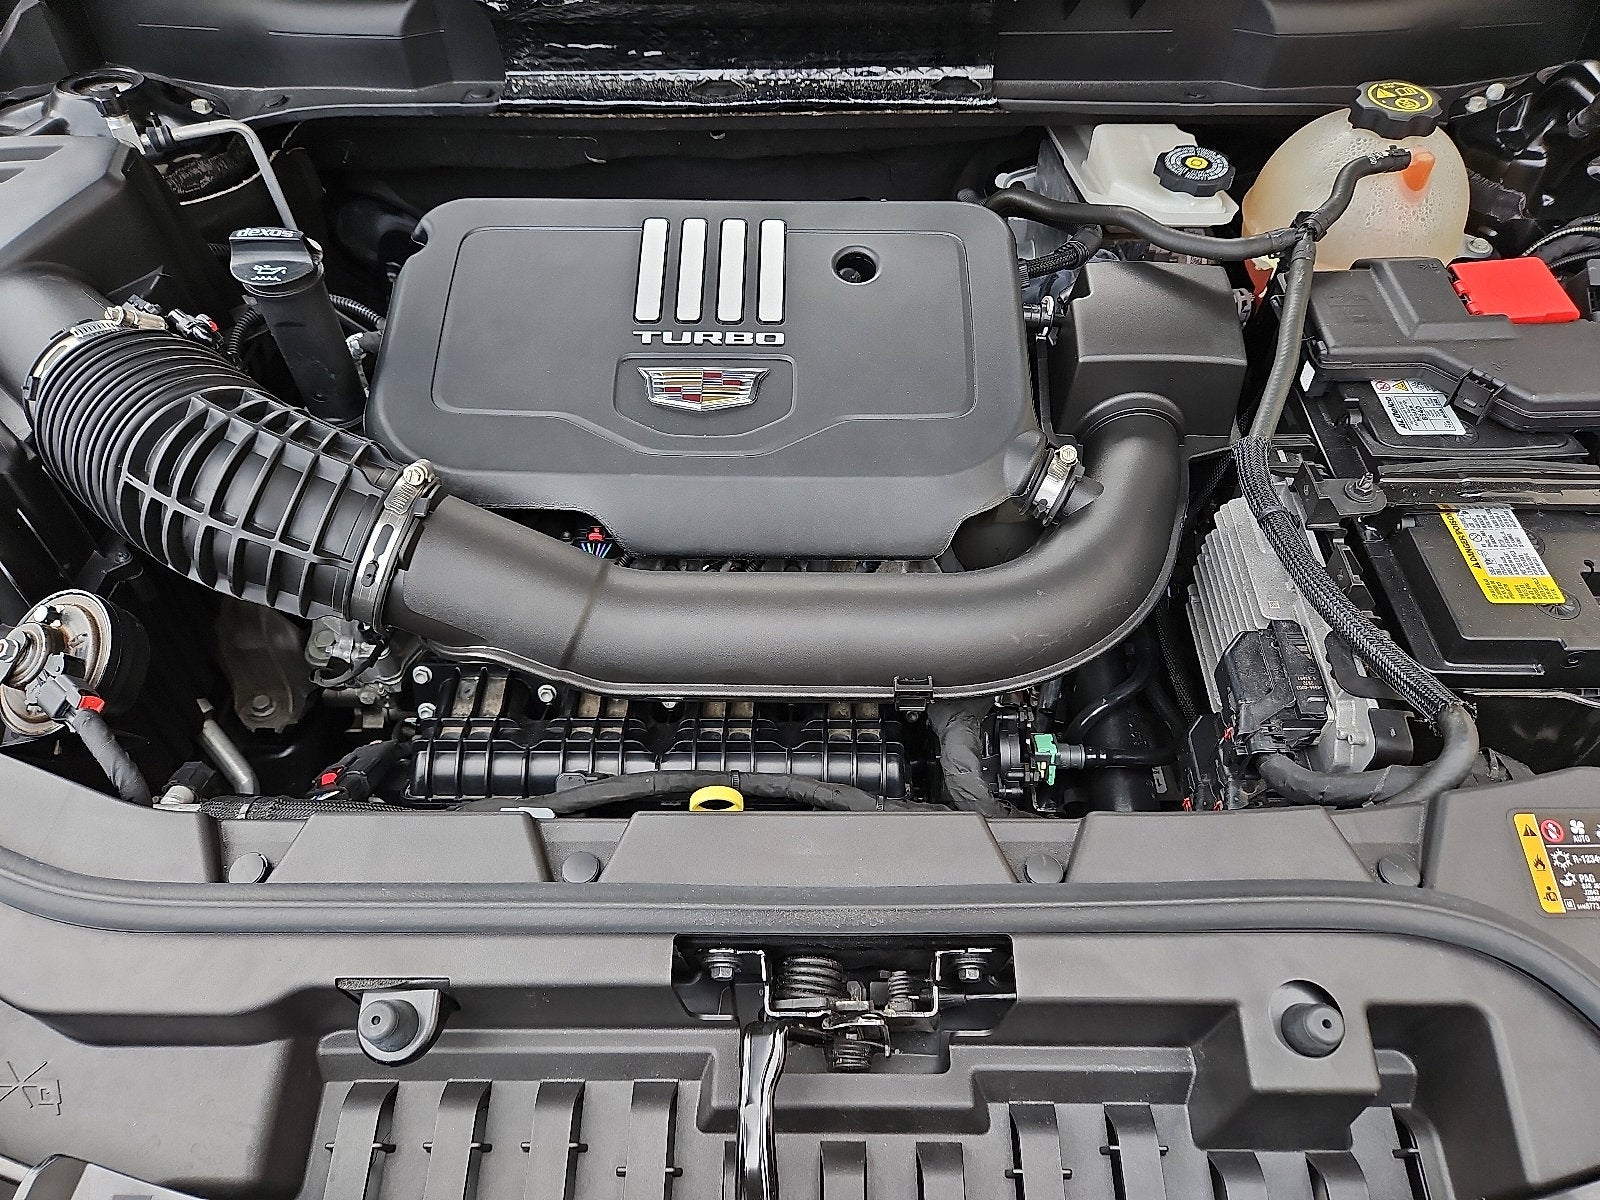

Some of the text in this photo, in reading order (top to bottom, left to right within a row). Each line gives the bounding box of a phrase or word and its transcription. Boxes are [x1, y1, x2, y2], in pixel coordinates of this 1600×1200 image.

[236, 227, 297, 238] dexos
[632, 331, 785, 345] TURBO
[1458, 534, 1478, 562] DANGER
[1572, 834, 1591, 843] AUTO
[1578, 873, 1596, 883] PAG
